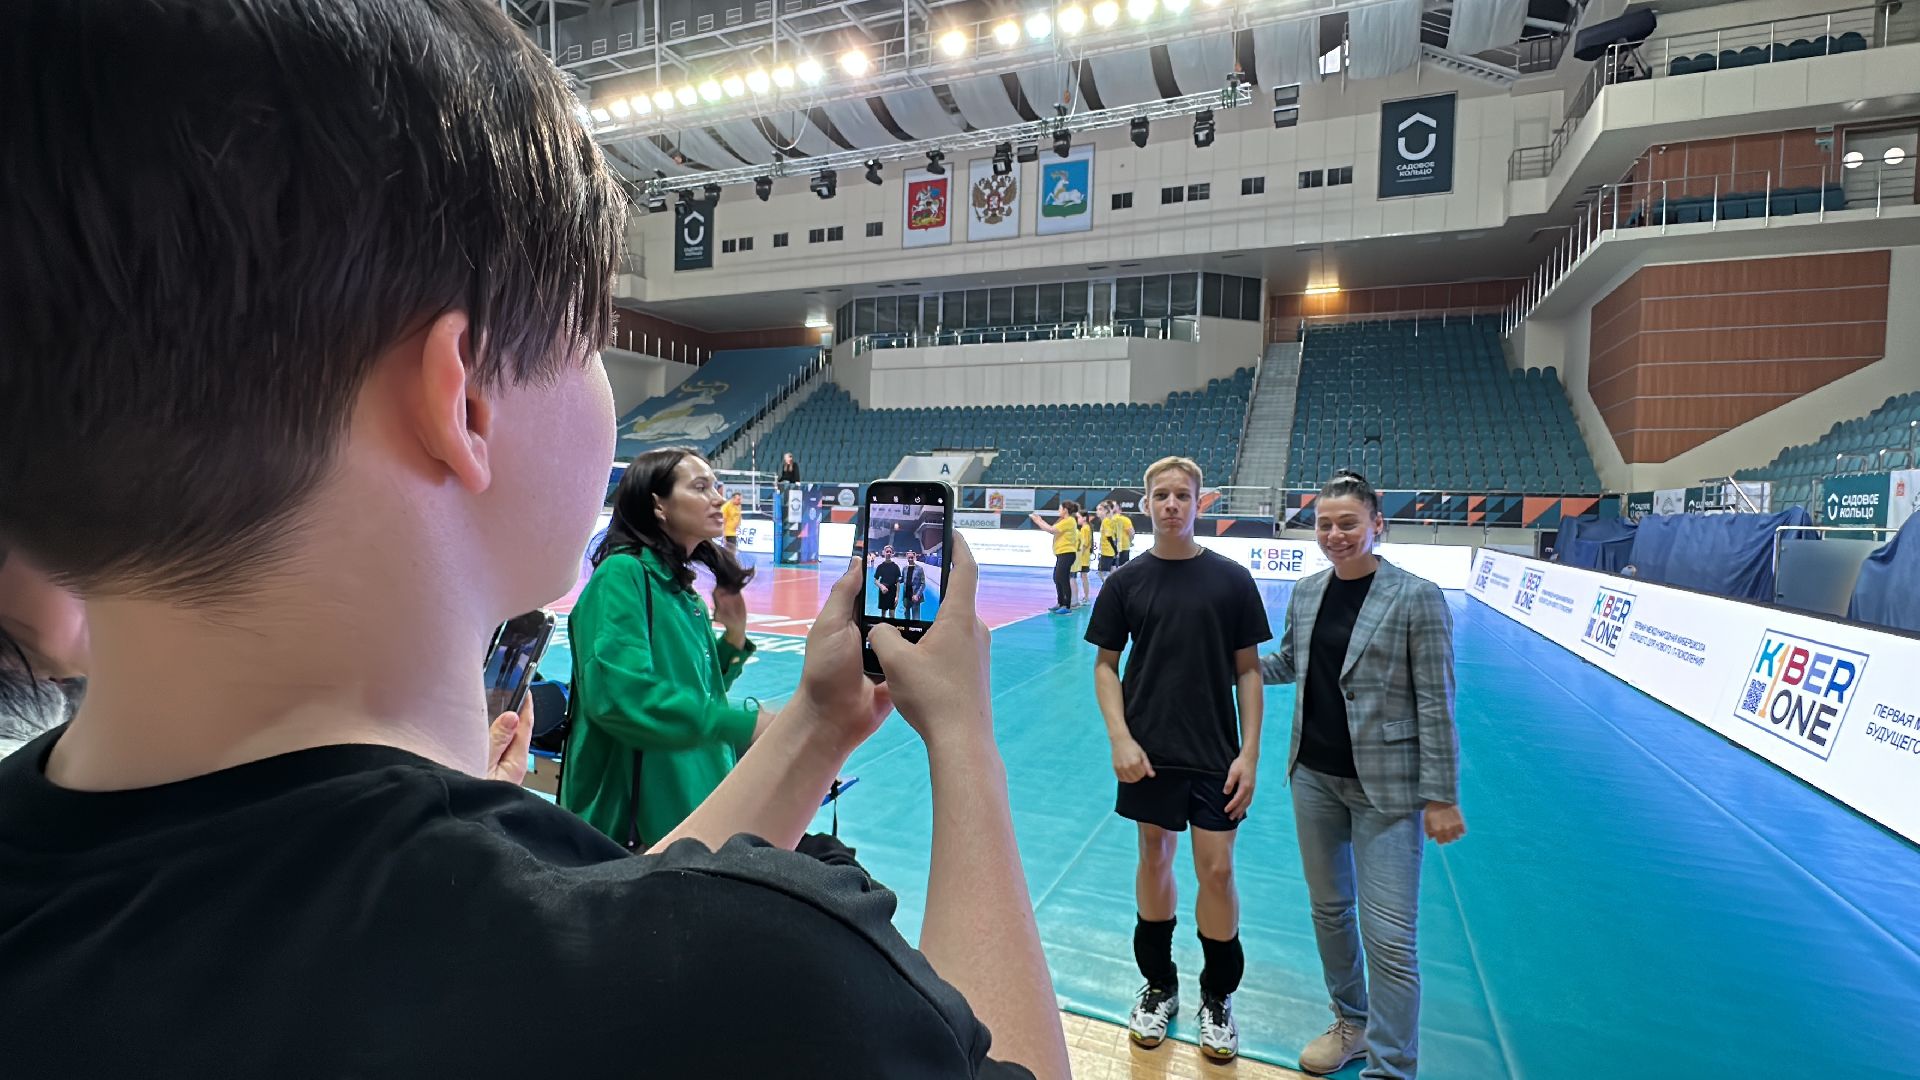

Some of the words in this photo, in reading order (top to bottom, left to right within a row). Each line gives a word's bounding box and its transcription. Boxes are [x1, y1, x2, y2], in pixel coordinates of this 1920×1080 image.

[1396, 161, 1435, 171] САДОВОЕ
[1399, 168, 1432, 176] КОЛЬЦО
[1841, 493, 1879, 506] САДОВОЕ
[1840, 506, 1873, 519] КОЛЬЦО
[1268, 561, 1302, 572] ONE
[1595, 620, 1622, 649] ONE
[1770, 689, 1838, 747] ONE
[1873, 703, 1914, 727] ПЕРВАЯ
